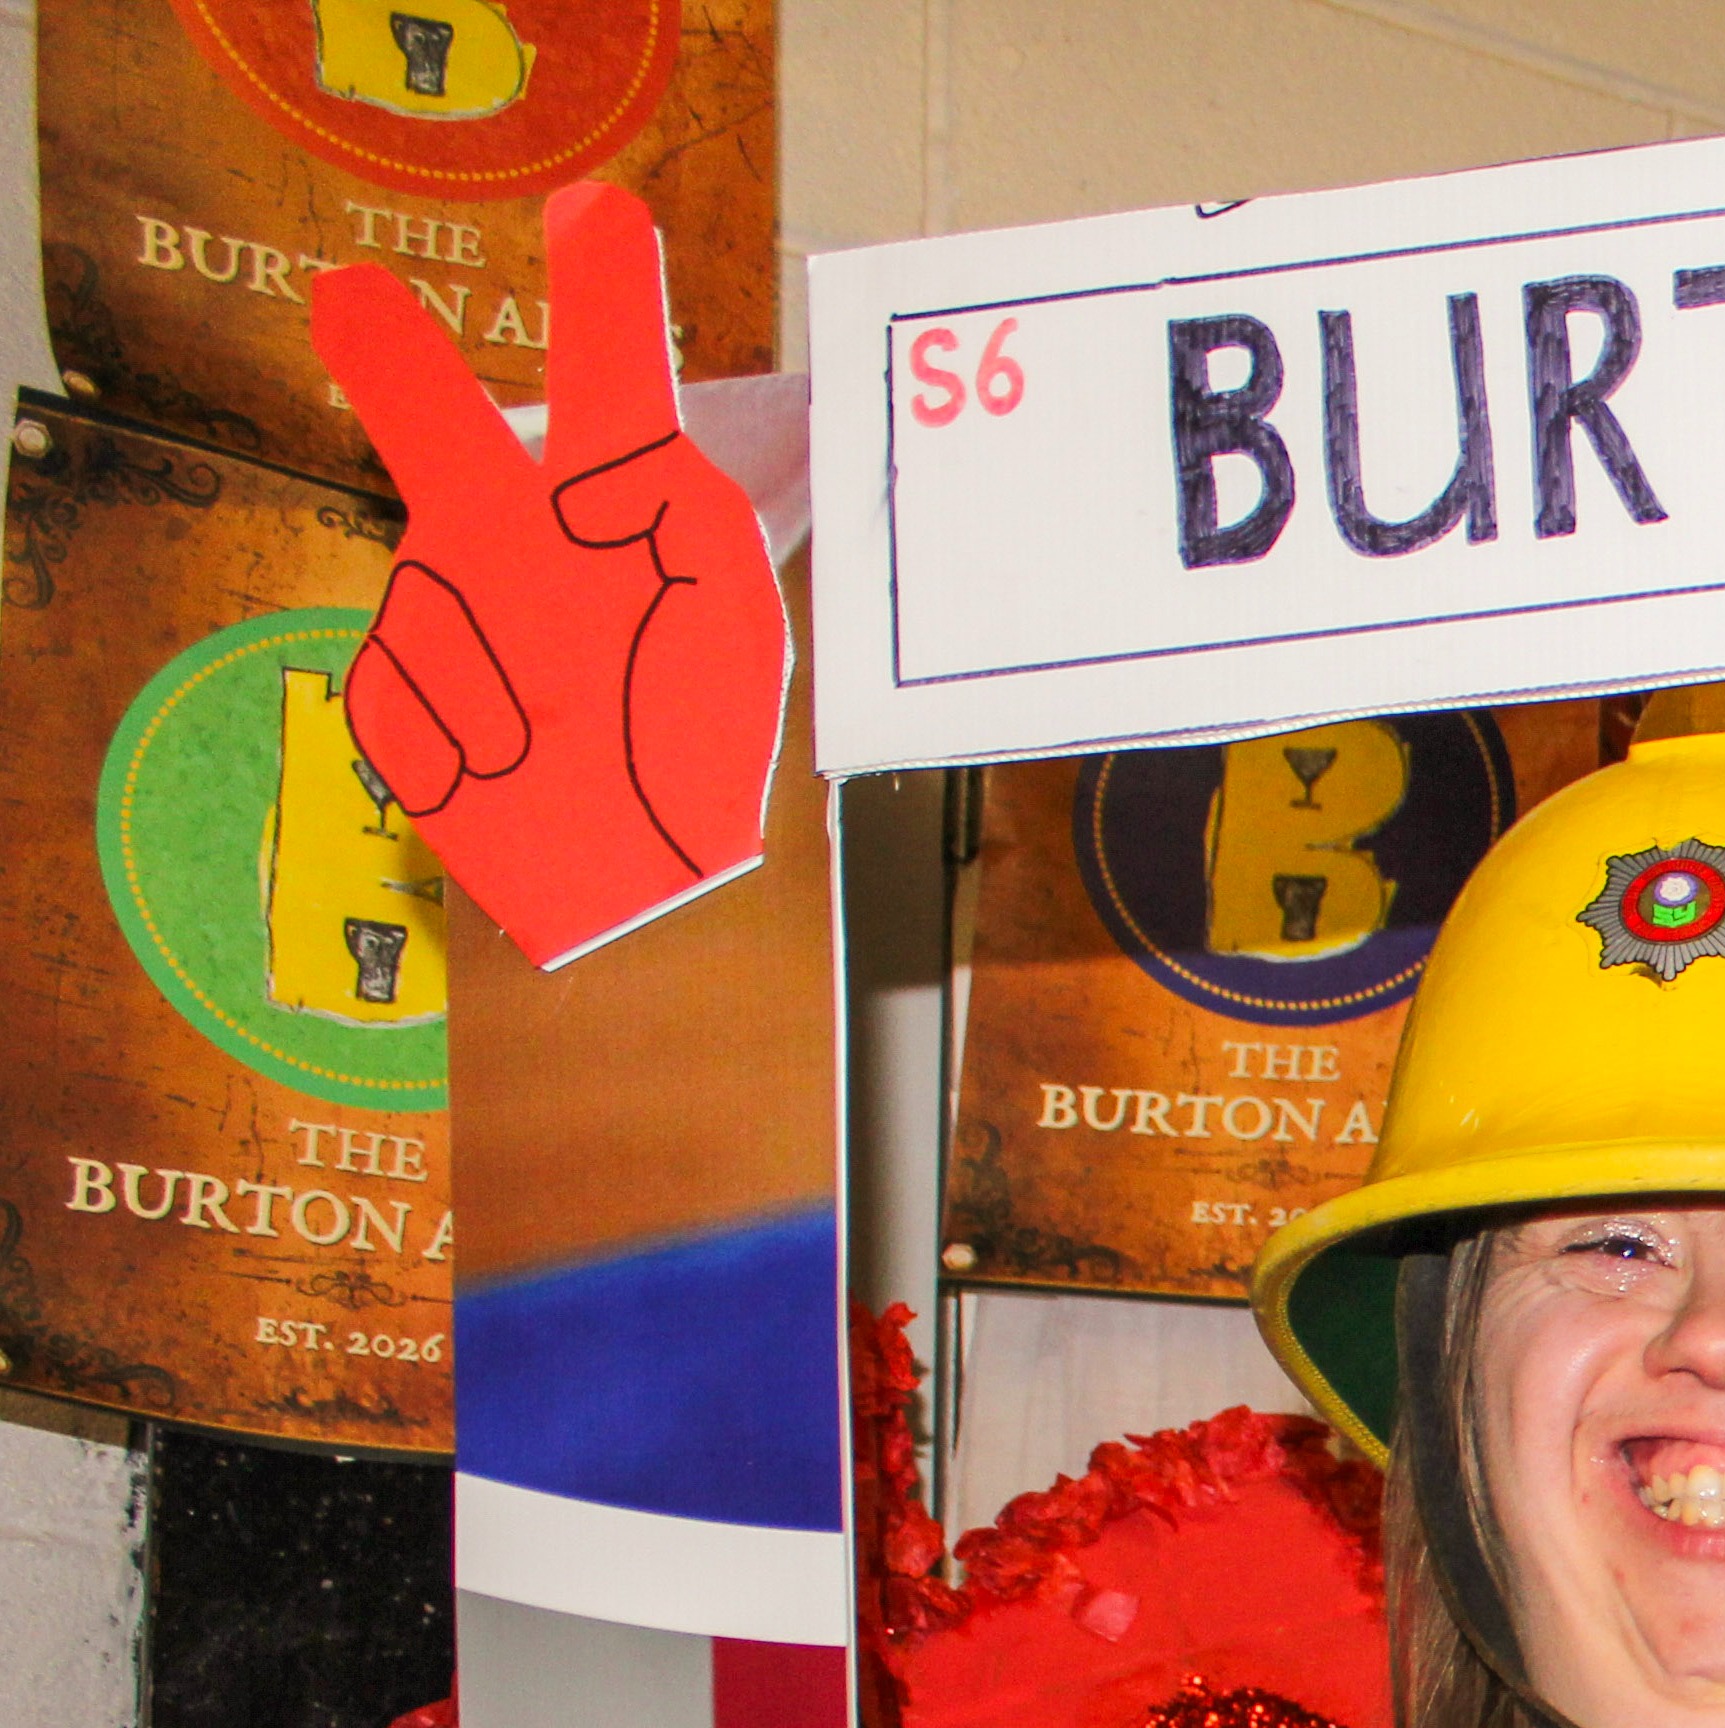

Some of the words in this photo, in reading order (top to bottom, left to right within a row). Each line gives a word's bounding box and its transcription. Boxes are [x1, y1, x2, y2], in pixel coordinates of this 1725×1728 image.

[345, 200, 487, 269] THE
[136, 215, 472, 336] BURN
[909, 317, 1025, 429] S6
[1220, 1040, 1342, 1084] THE
[1036, 1082, 1326, 1144] BURTON
[288, 1117, 429, 1183] THE
[65, 1155, 412, 1254] BURTON
[1190, 1200, 1258, 1227] EST.
[254, 1316, 335, 1351] EST.
[346, 1331, 446, 1363] 2026
